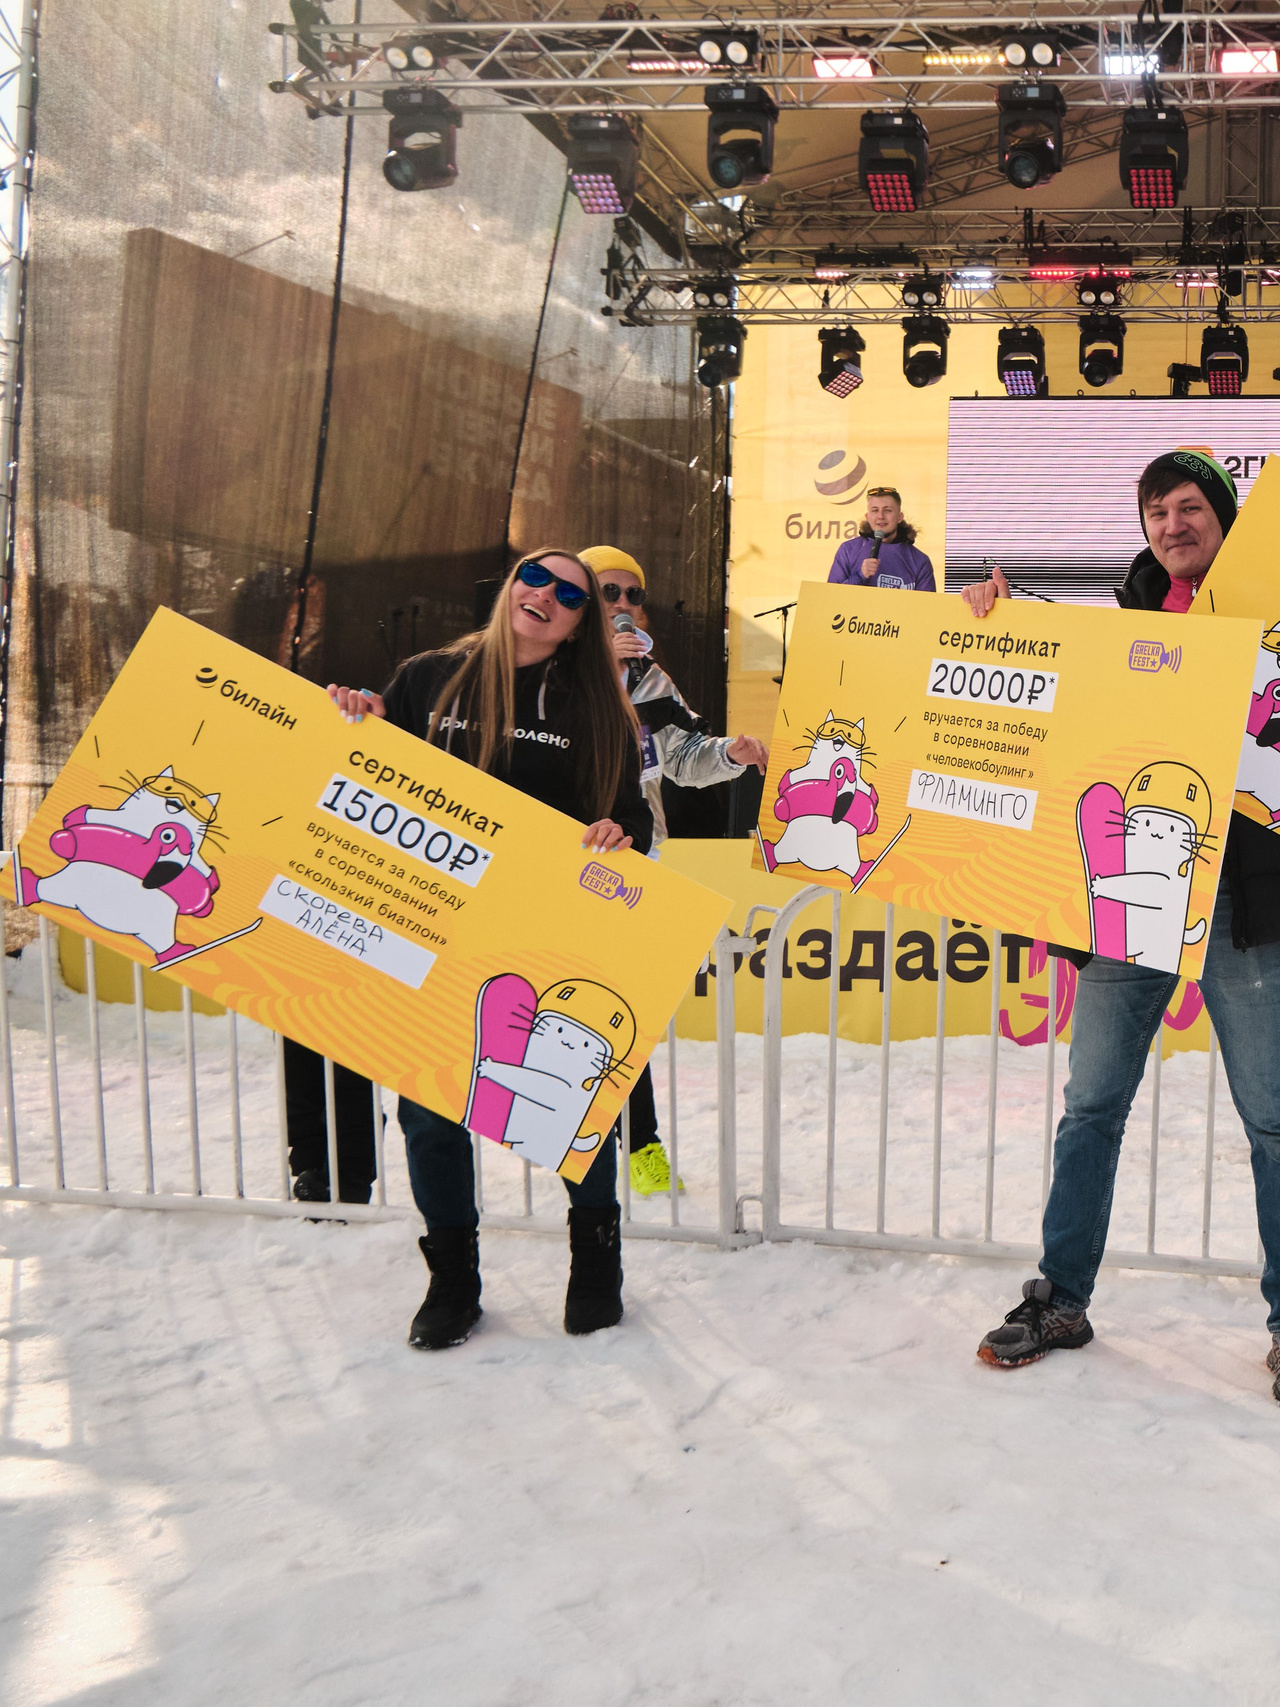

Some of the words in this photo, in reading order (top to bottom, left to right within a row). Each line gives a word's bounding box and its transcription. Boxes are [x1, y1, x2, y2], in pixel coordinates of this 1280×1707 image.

[785, 512, 859, 540] била
[848, 615, 900, 639] билайн
[938, 629, 1061, 659] сертификат
[1135, 644, 1161, 657] GRELKA
[1132, 655, 1150, 668] FEST
[220, 679, 297, 730] билайн
[923, 711, 982, 729] вручается
[986, 720, 999, 731] за
[1003, 722, 1048, 742] победу
[933, 732, 940, 742] в
[943, 733, 1030, 756] соревновании
[349, 750, 504, 838] сертификат
[918, 772, 1027, 821] ФЛАМИНГО
[306, 821, 386, 869] вручается
[388, 863, 405, 878] за
[409, 874, 467, 911] победу
[589, 865, 619, 887] GRELKA
[314, 848, 324, 859] в
[328, 855, 438, 917] соревновании
[584, 875, 606, 891] FEST
[288, 858, 374, 909] «скользкий
[378, 902, 447, 946] биатлон»
[296, 908, 367, 957] АЛЁНА
